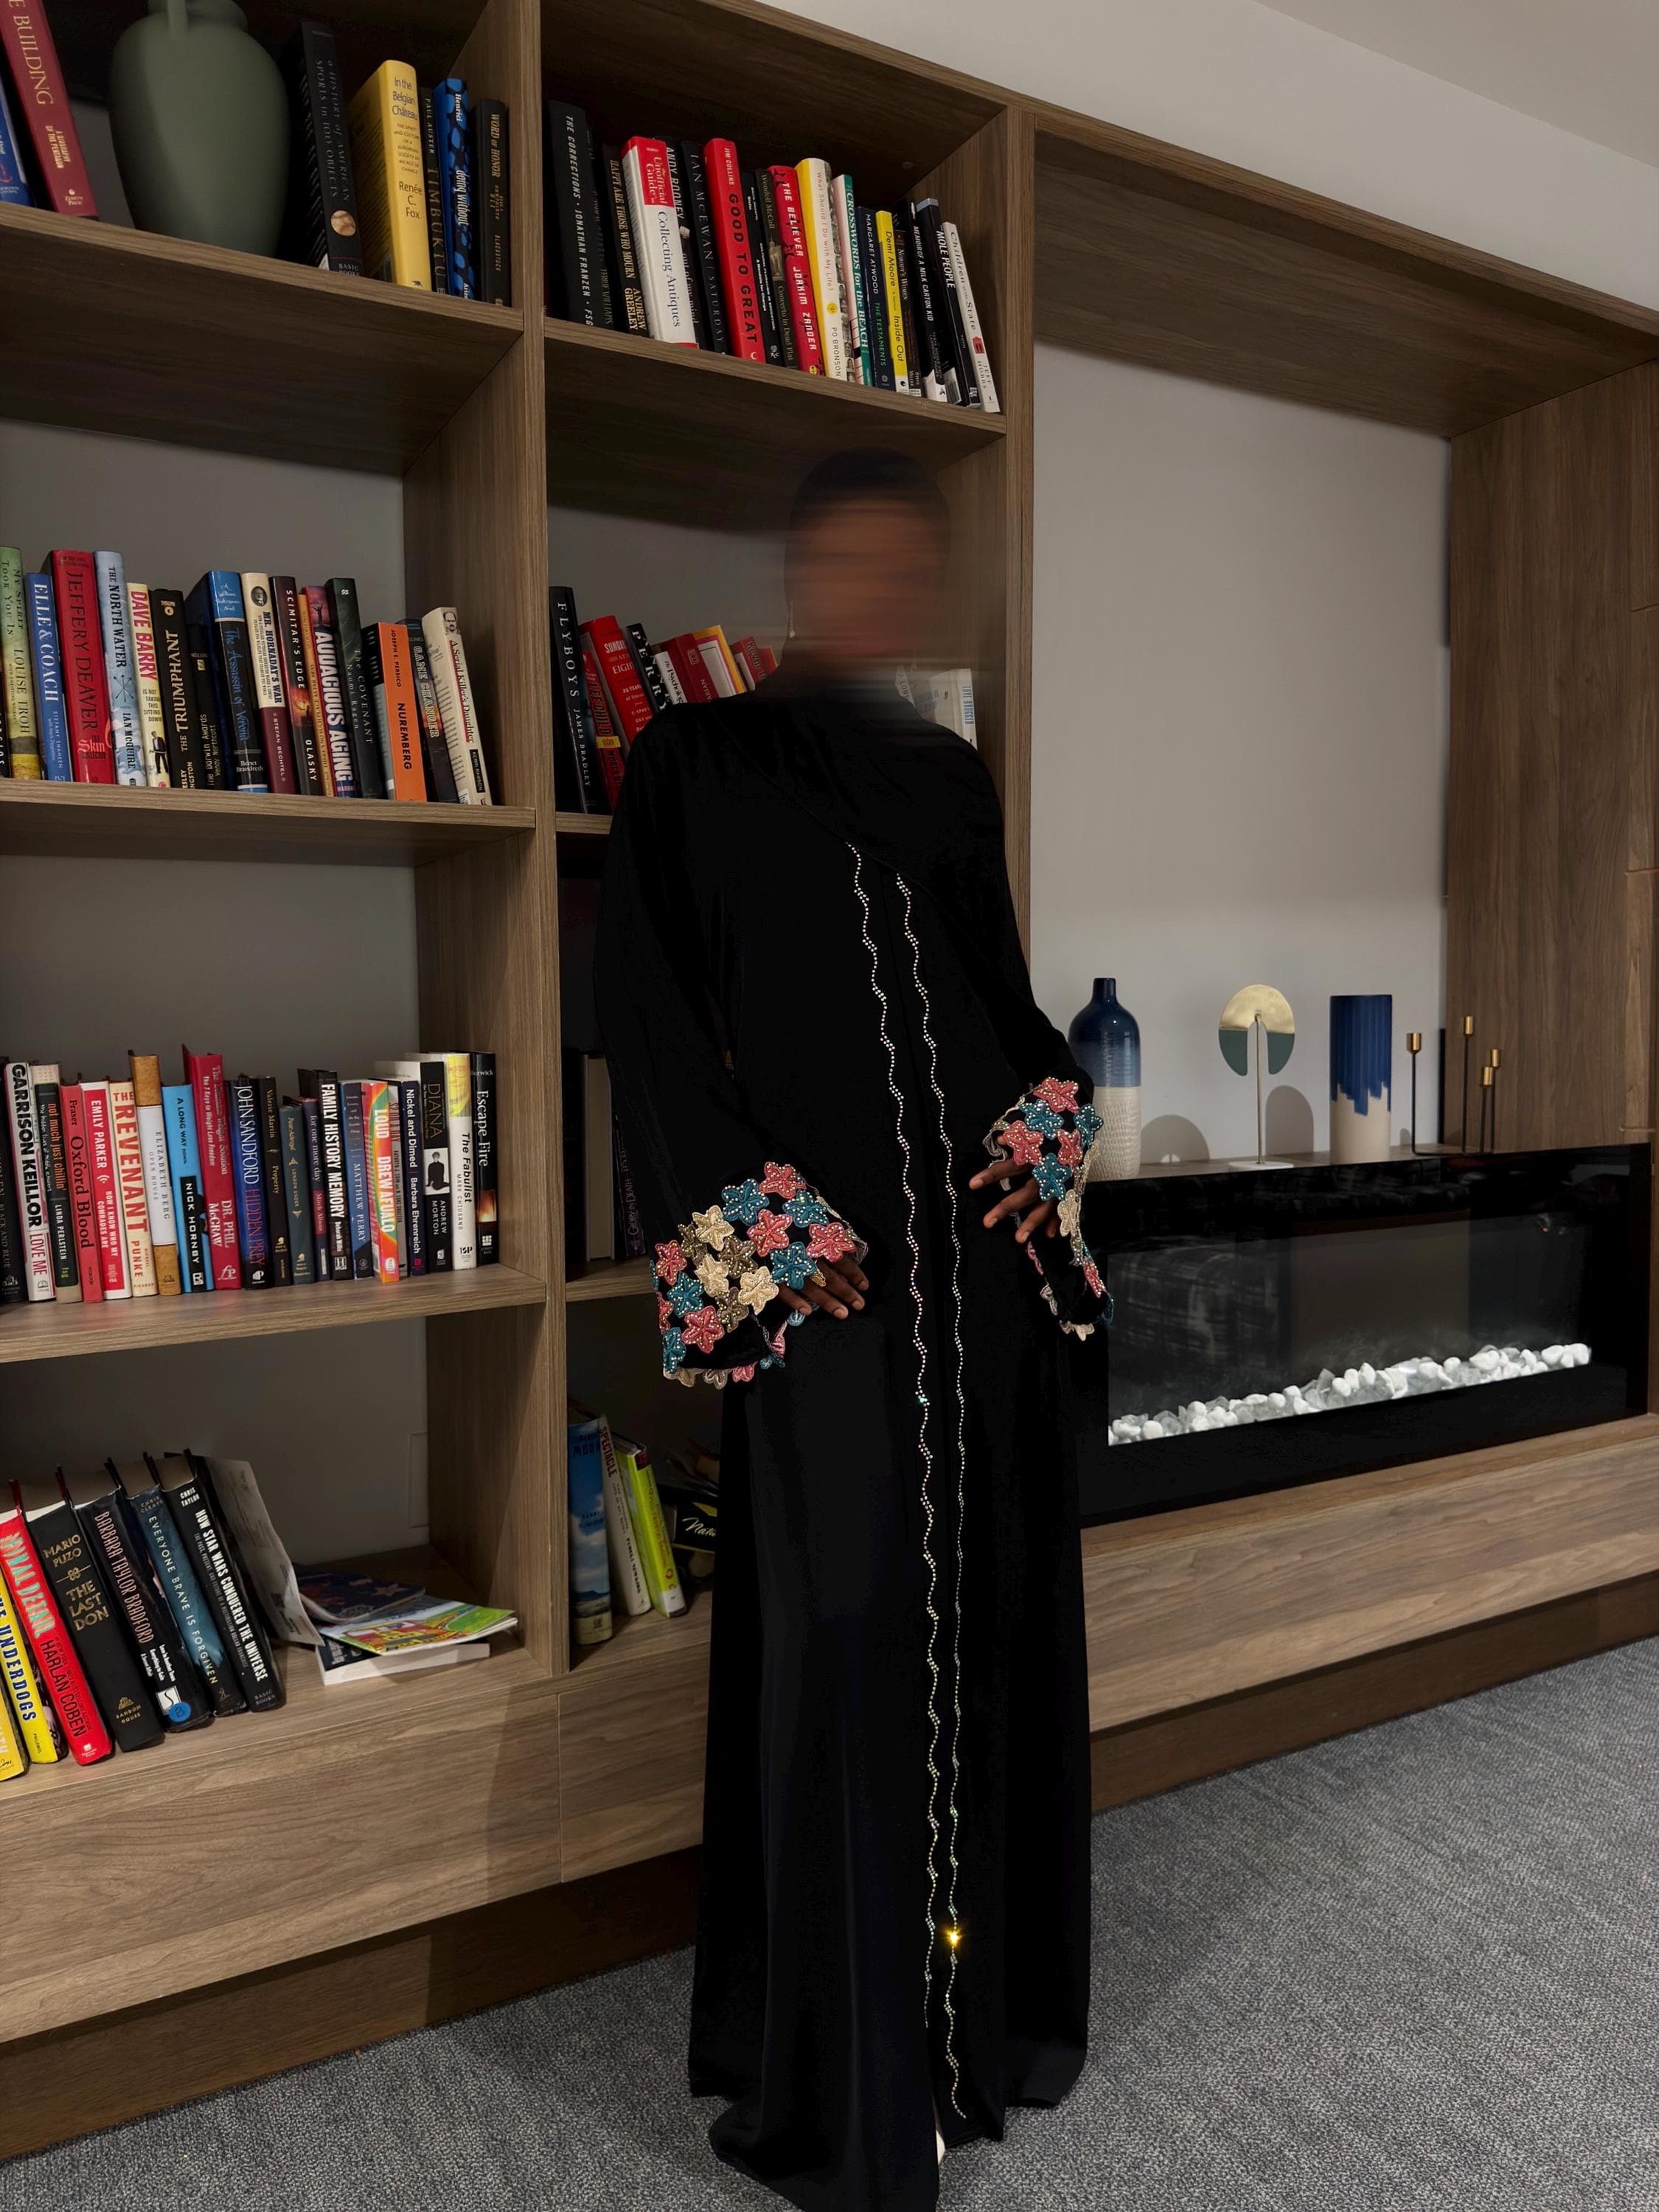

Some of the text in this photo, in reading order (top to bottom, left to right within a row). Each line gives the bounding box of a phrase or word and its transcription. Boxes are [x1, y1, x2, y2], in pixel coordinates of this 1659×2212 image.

[13, 15, 54, 105] BUILDING
[394, 77, 413, 90] In the
[392, 91, 415, 105] Belgian
[392, 105, 418, 121] Château
[491, 113, 500, 137] WORD
[427, 122, 435, 155] AUSTER
[492, 147, 501, 178] HONOR
[566, 115, 581, 200] THE CORRECTIONS
[399, 181, 422, 195] Renée
[408, 195, 417, 206] C.
[645, 164, 655, 195] Guide
[653, 156, 667, 205] Unofficial
[406, 207, 420, 220] Fox
[427, 167, 446, 280] TIMBUKTU
[783, 183, 804, 257] THE BELIEVER
[574, 209, 591, 296] JONATHAN FRANZEN
[658, 212, 680, 327] Collecting Antiques
[728, 193, 758, 344] GOOD TO GREAT
[846, 192, 860, 270] CROSSWORDS
[858, 309, 868, 348] BEACH
[865, 213, 878, 294] MARGARET ATWOOD
[887, 257, 896, 287] Moore
[936, 230, 956, 290] MOLE PEOPLE
[625, 288, 647, 331] ANDREW GREELEY
[708, 276, 723, 343] SATURDAY
[803, 312, 816, 350] ZANDER
[876, 315, 886, 366] TESTAMENTS
[896, 344, 904, 362] Out
[34, 583, 59, 702] ELLE & COACH
[66, 570, 89, 653] JEFFERY
[108, 567, 127, 669] THE NORTH WATER
[131, 591, 158, 681] DAVE BARRY
[286, 589, 305, 689] SCIMITAR'S EDGE
[165, 629, 189, 734] TRIUMPHANT
[265, 630, 279, 683] HORNADAY'S
[557, 602, 580, 697] FLYBOYS
[14, 650, 30, 734] LOUISE TROH
[76, 657, 97, 731] DEAVER
[315, 631, 354, 781] AUDACIOUS AGING
[305, 740, 317, 781] OLASKY
[397, 703, 411, 770] NUREMBERG
[574, 708, 591, 787] JAMES BRADLEY
[69, 1099, 77, 1126] Fraser
[114, 1093, 133, 1102] THE
[373, 1109, 389, 1139] LOUD
[406, 1089, 417, 1168] Nickel and Dimed
[428, 1083, 442, 1139] DIANA
[474, 1090, 491, 1167] Escape Fire
[12, 1064, 42, 1228] GARRISON KEILLOR
[47, 1103, 66, 1194] not much just chillin'
[91, 1099, 107, 1169] EMILY PARKER
[234, 1085, 260, 1186] JOHN SANDFORD
[321, 1085, 345, 1219] FAMILY HISTORY MEMORY
[70, 1135, 94, 1249] Oxford Blood
[115, 1105, 147, 1232] REVENANT
[156, 1132, 170, 1220] ELIZABETH BERG
[462, 1133, 472, 1203] The Fabulist
[97, 1200, 106, 1234] COMRADES
[108, 1209, 116, 1229] KNOW
[112, 1245, 118, 1256] MY
[186, 1183, 199, 1264] NICK HORNBY
[209, 1203, 222, 1247] McGRAW
[222, 1200, 234, 1248] DR. PHIL
[245, 1188, 266, 1266] HIDDEN PREY
[353, 1163, 366, 1242] MATTHEW PERRY
[410, 1177, 420, 1254] Barbara Ehrenreich
[29, 1232, 47, 1276] LOVE ME
[57, 1226, 66, 1260] PERLSTEIN
[131, 1241, 143, 1278] PUNKE
[600, 1426, 617, 1477] SPECTACLE
[43, 1534, 81, 1559] MARIO
[52, 1548, 81, 1568] PUZO
[95, 1511, 154, 1645] BARBARA TAYLOR BRADFORD
[66, 1579, 94, 1601] THE
[70, 1593, 101, 1616] LAST
[74, 1607, 109, 1631] DON
[149, 1516, 218, 1685] EVERYONE BRAVE IS FORGIVEN
[195, 1509, 268, 1682] HOW STAR WARS CONQUERED THE UNIVERSE
[0, 1625, 36, 1720] UNDERDOGS
[40, 1639, 86, 1737] HARLAN COBEN
[33, 1733, 41, 1753] PHILOMEL
[116, 1703, 142, 1719] RANDOM
[121, 1712, 142, 1724] HOUSE
